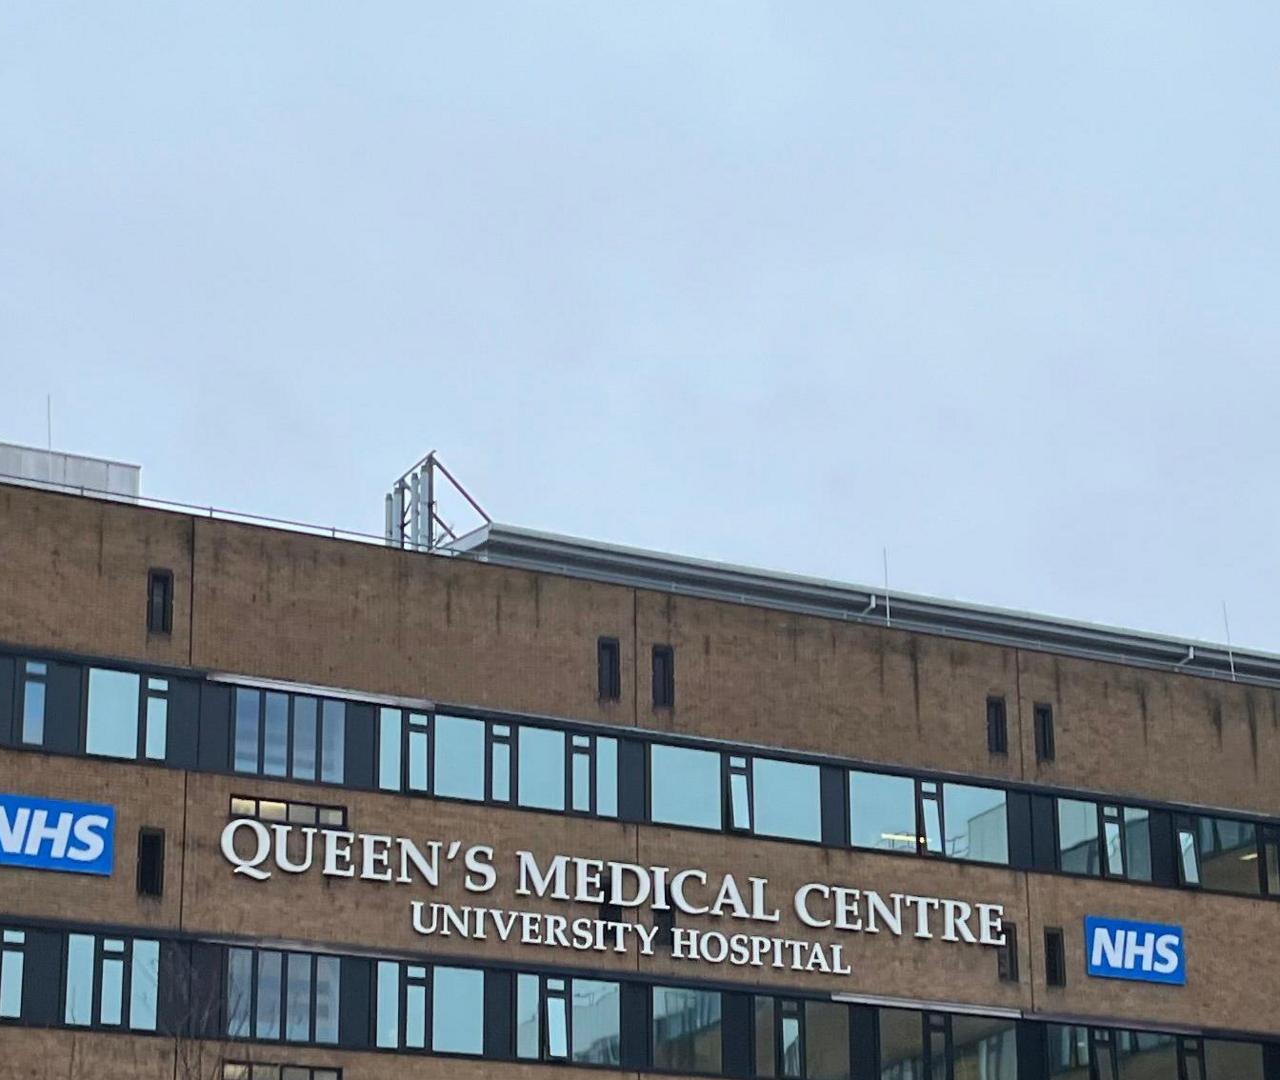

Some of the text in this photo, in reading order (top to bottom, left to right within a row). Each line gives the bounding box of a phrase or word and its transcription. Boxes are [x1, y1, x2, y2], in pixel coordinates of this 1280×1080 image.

[220, 818, 1007, 947] QUEEN'S MEDICAL CENTRE
[410, 900, 852, 976] UNIVERSITY HOSPITAL
[1091, 927, 1180, 974] NHS
